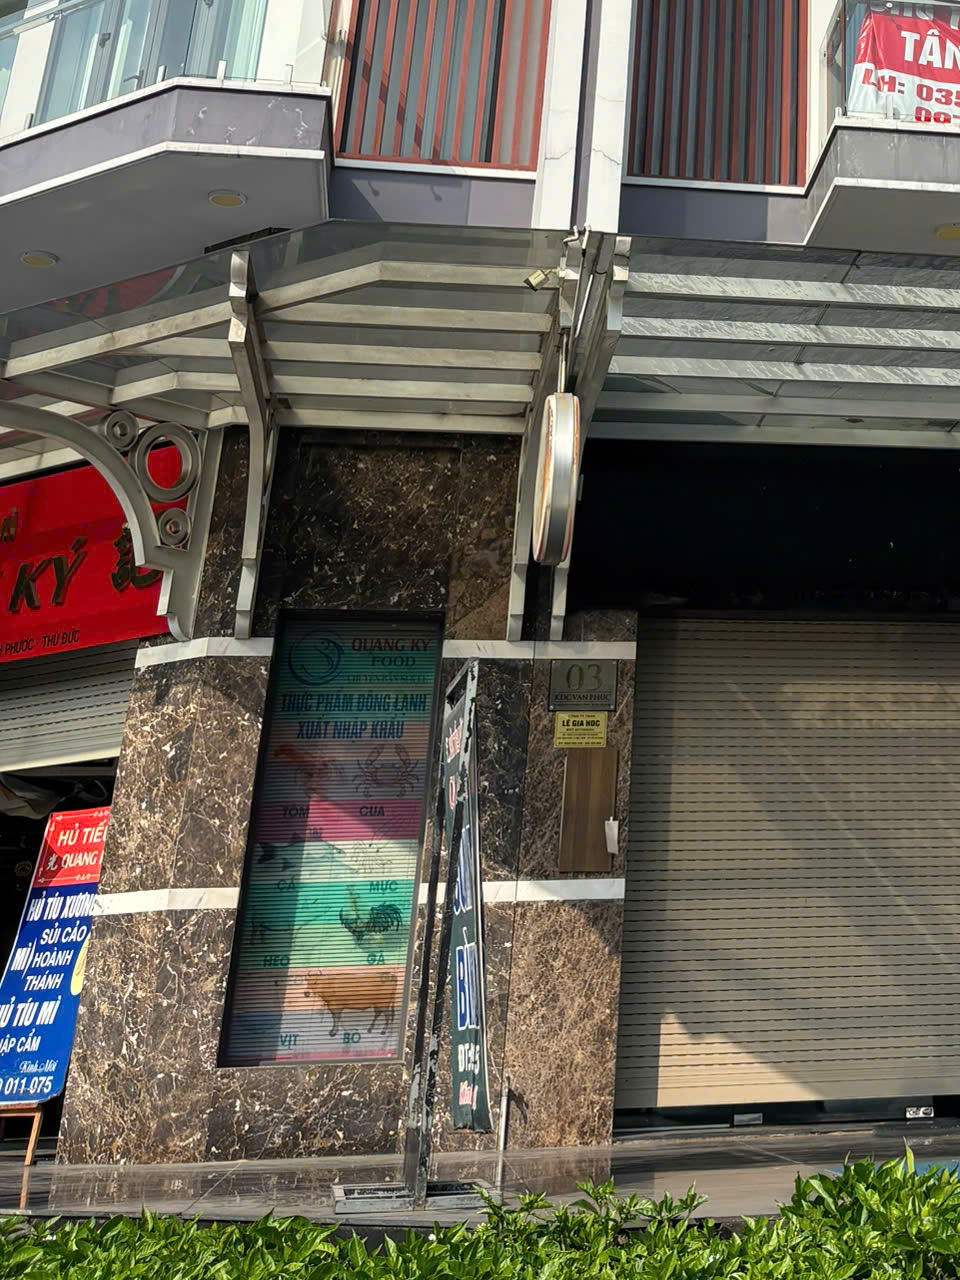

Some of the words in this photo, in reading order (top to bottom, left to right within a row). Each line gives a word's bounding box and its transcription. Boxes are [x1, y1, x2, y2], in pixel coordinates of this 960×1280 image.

[8, 537, 88, 613] KÝ
[567, 664, 601, 690] 03
[57, 823, 79, 846] HỦ
[61, 851, 98, 869] QUANG
[27, 891, 46, 921] HỦ
[41, 922, 61, 944] SỦI
[62, 920, 87, 942] CẢO
[32, 949, 74, 968] HOÀNH
[24, 970, 64, 991] THÁNH
[17, 1028, 41, 1053] CẨM
